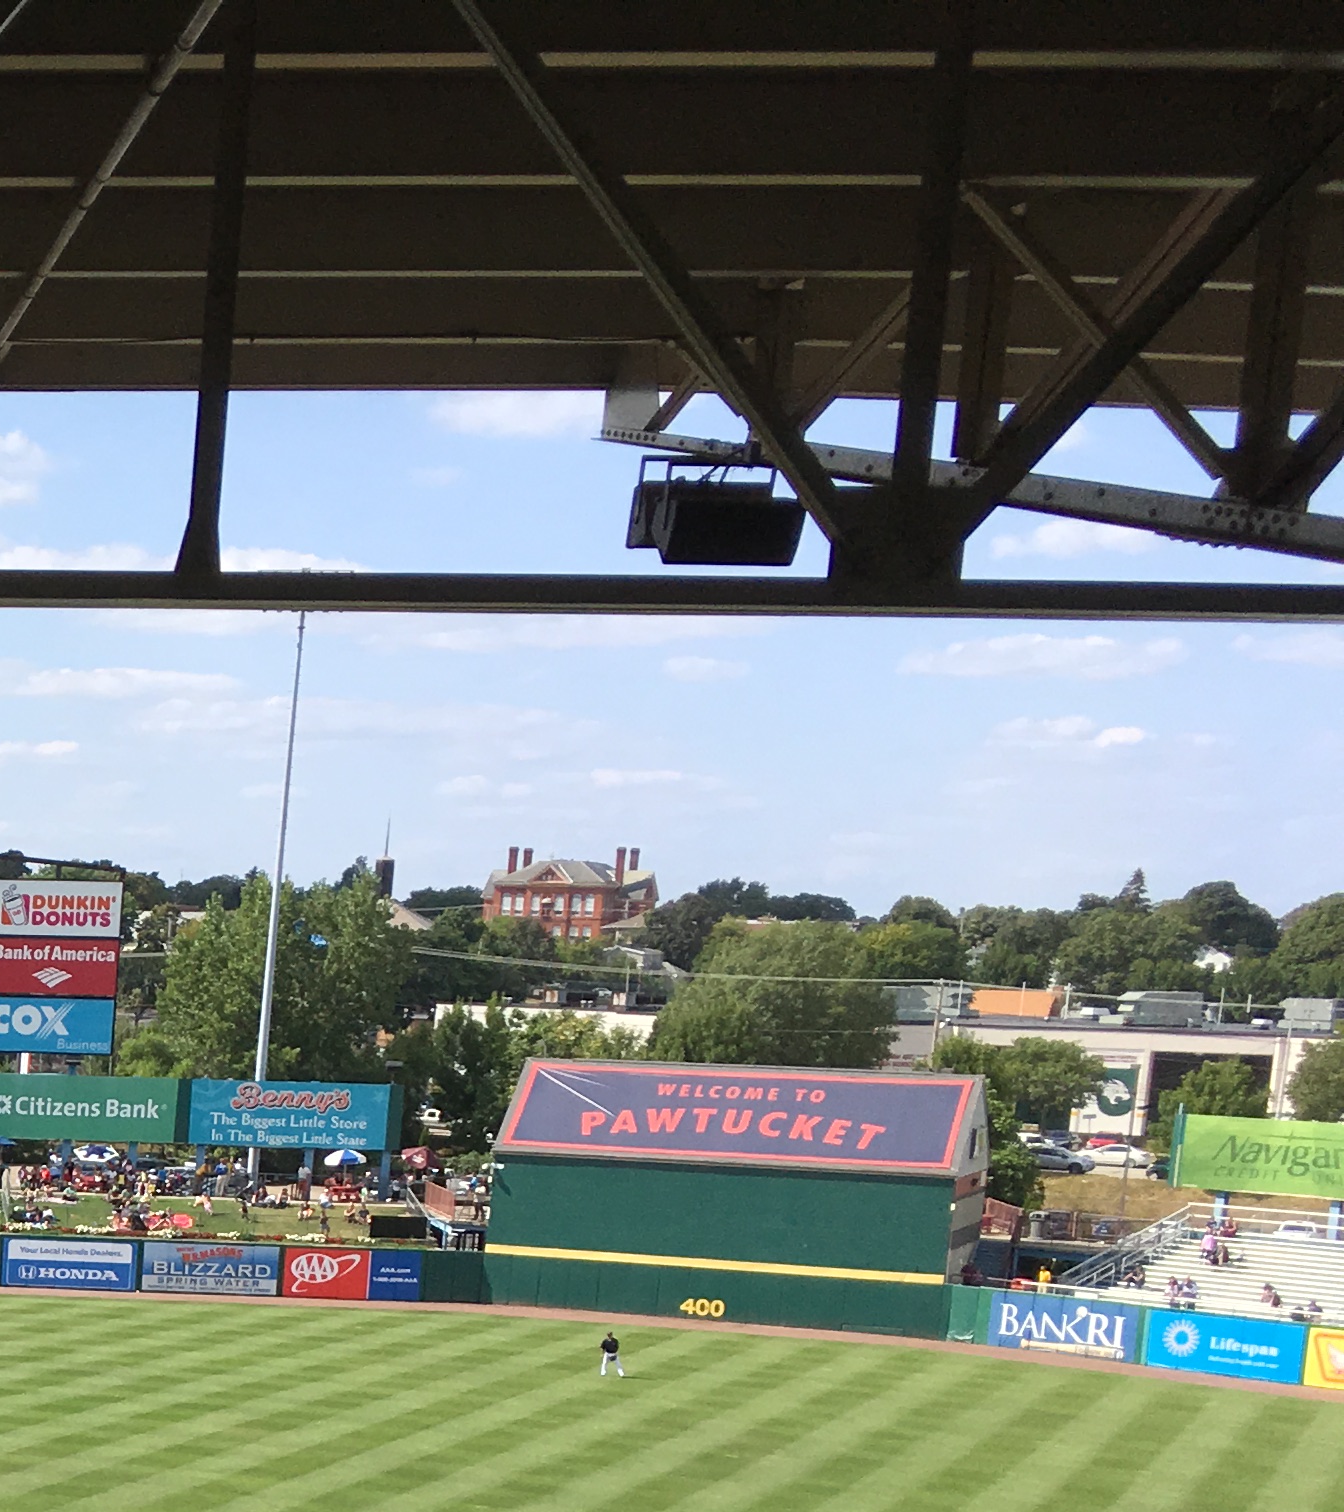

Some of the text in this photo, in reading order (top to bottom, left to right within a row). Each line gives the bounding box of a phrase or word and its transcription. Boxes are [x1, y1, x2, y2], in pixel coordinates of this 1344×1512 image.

[32, 895, 117, 910] DUNKIN'
[32, 911, 111, 927] DONUTS
[33, 944, 53, 961] of
[54, 946, 116, 962] America
[231, 1082, 351, 1114] Benny's
[657, 1083, 826, 1103] WELCOME TO
[15, 1096, 160, 1118] Citizens Bank
[211, 1112, 367, 1131] The Biggest Little Store
[580, 1106, 887, 1151] PAWTUCKET
[212, 1129, 367, 1147] In The Biggest Little State
[19, 1246, 37, 1254] Your
[39, 1246, 61, 1254] Local
[38, 1267, 120, 1281] HONDA
[153, 1260, 272, 1278] BLIZZARD
[293, 1254, 338, 1280] AAA
[157, 1276, 260, 1288] SPRING WATER
[679, 1298, 725, 1317] 400
[1209, 1336, 1280, 1359] Lifespan
